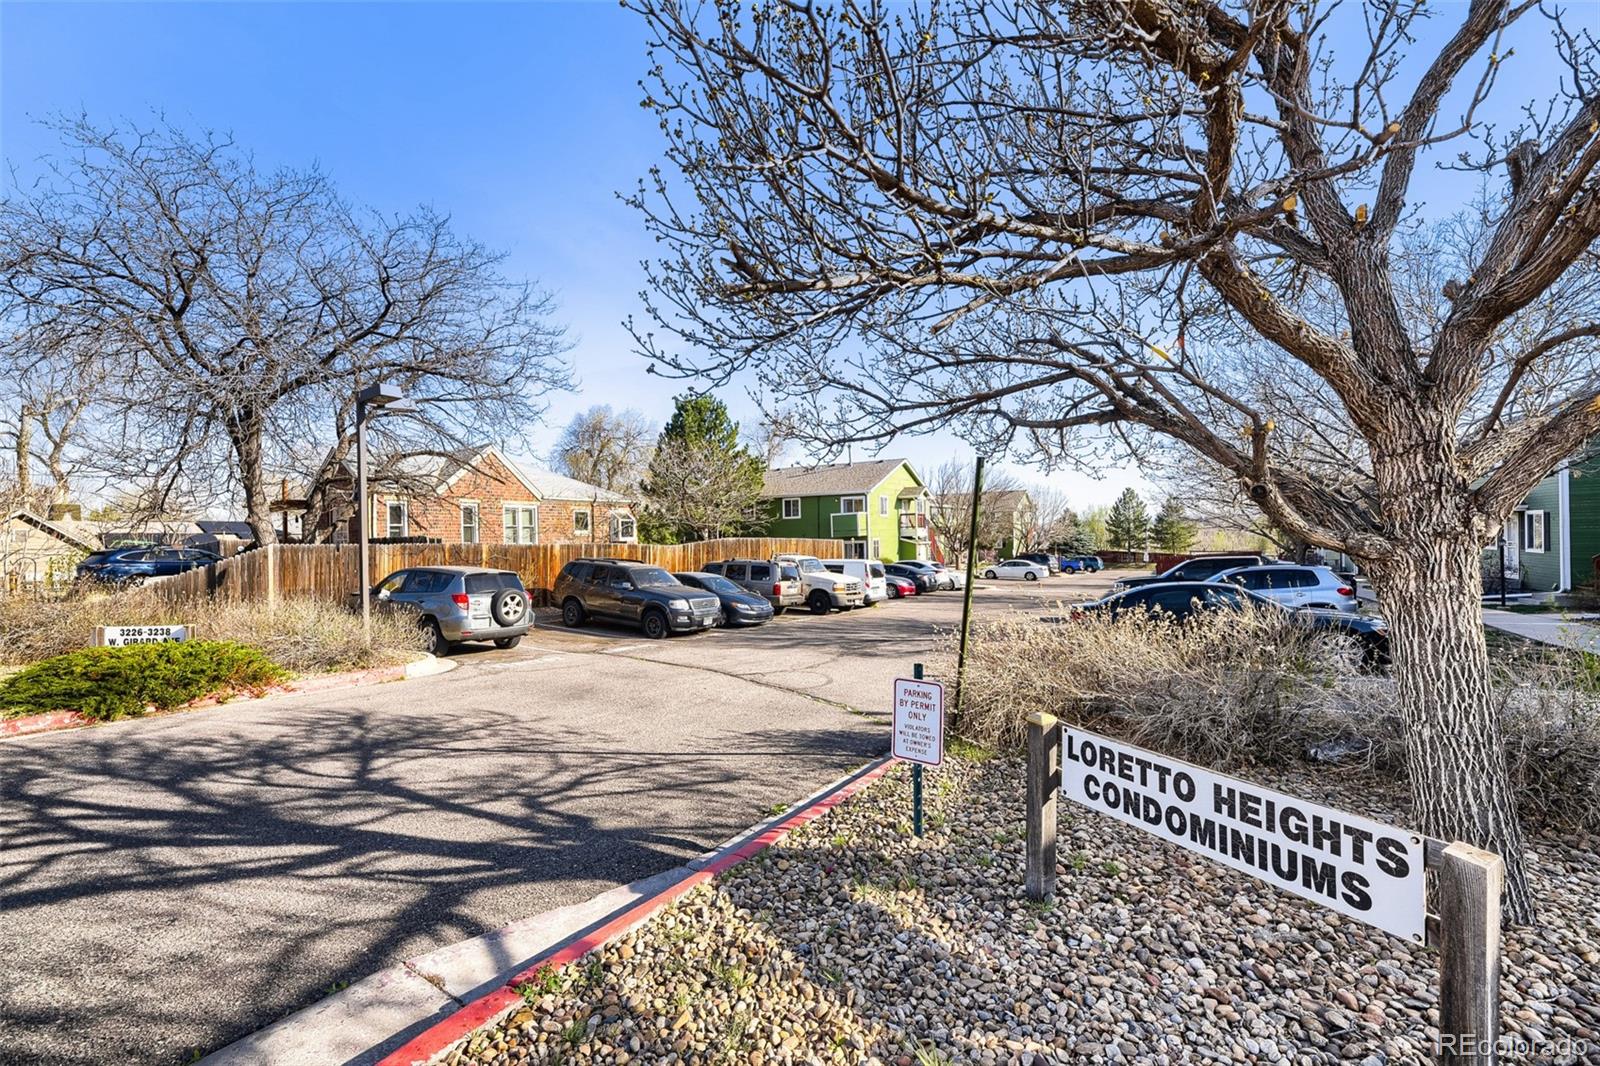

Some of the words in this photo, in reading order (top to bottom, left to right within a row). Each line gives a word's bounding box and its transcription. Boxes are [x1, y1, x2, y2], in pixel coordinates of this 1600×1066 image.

[120, 628, 171, 636] 3226-3238
[108, 638, 120, 646] W.
[904, 689, 932, 700] PARKING
[900, 698, 908, 707] BY
[910, 700, 936, 712] PERMIT
[908, 711, 926, 721] ONLY
[904, 724, 930, 733] VIOLATORS
[899, 730, 910, 738] WILL
[919, 734, 936, 742] TOWED
[906, 747, 927, 755] EXPENSE
[1067, 735, 1196, 803] LORETTO
[1213, 783, 1410, 879] HEIGHTS
[1084, 774, 1372, 911] CONDOMINIUMS
